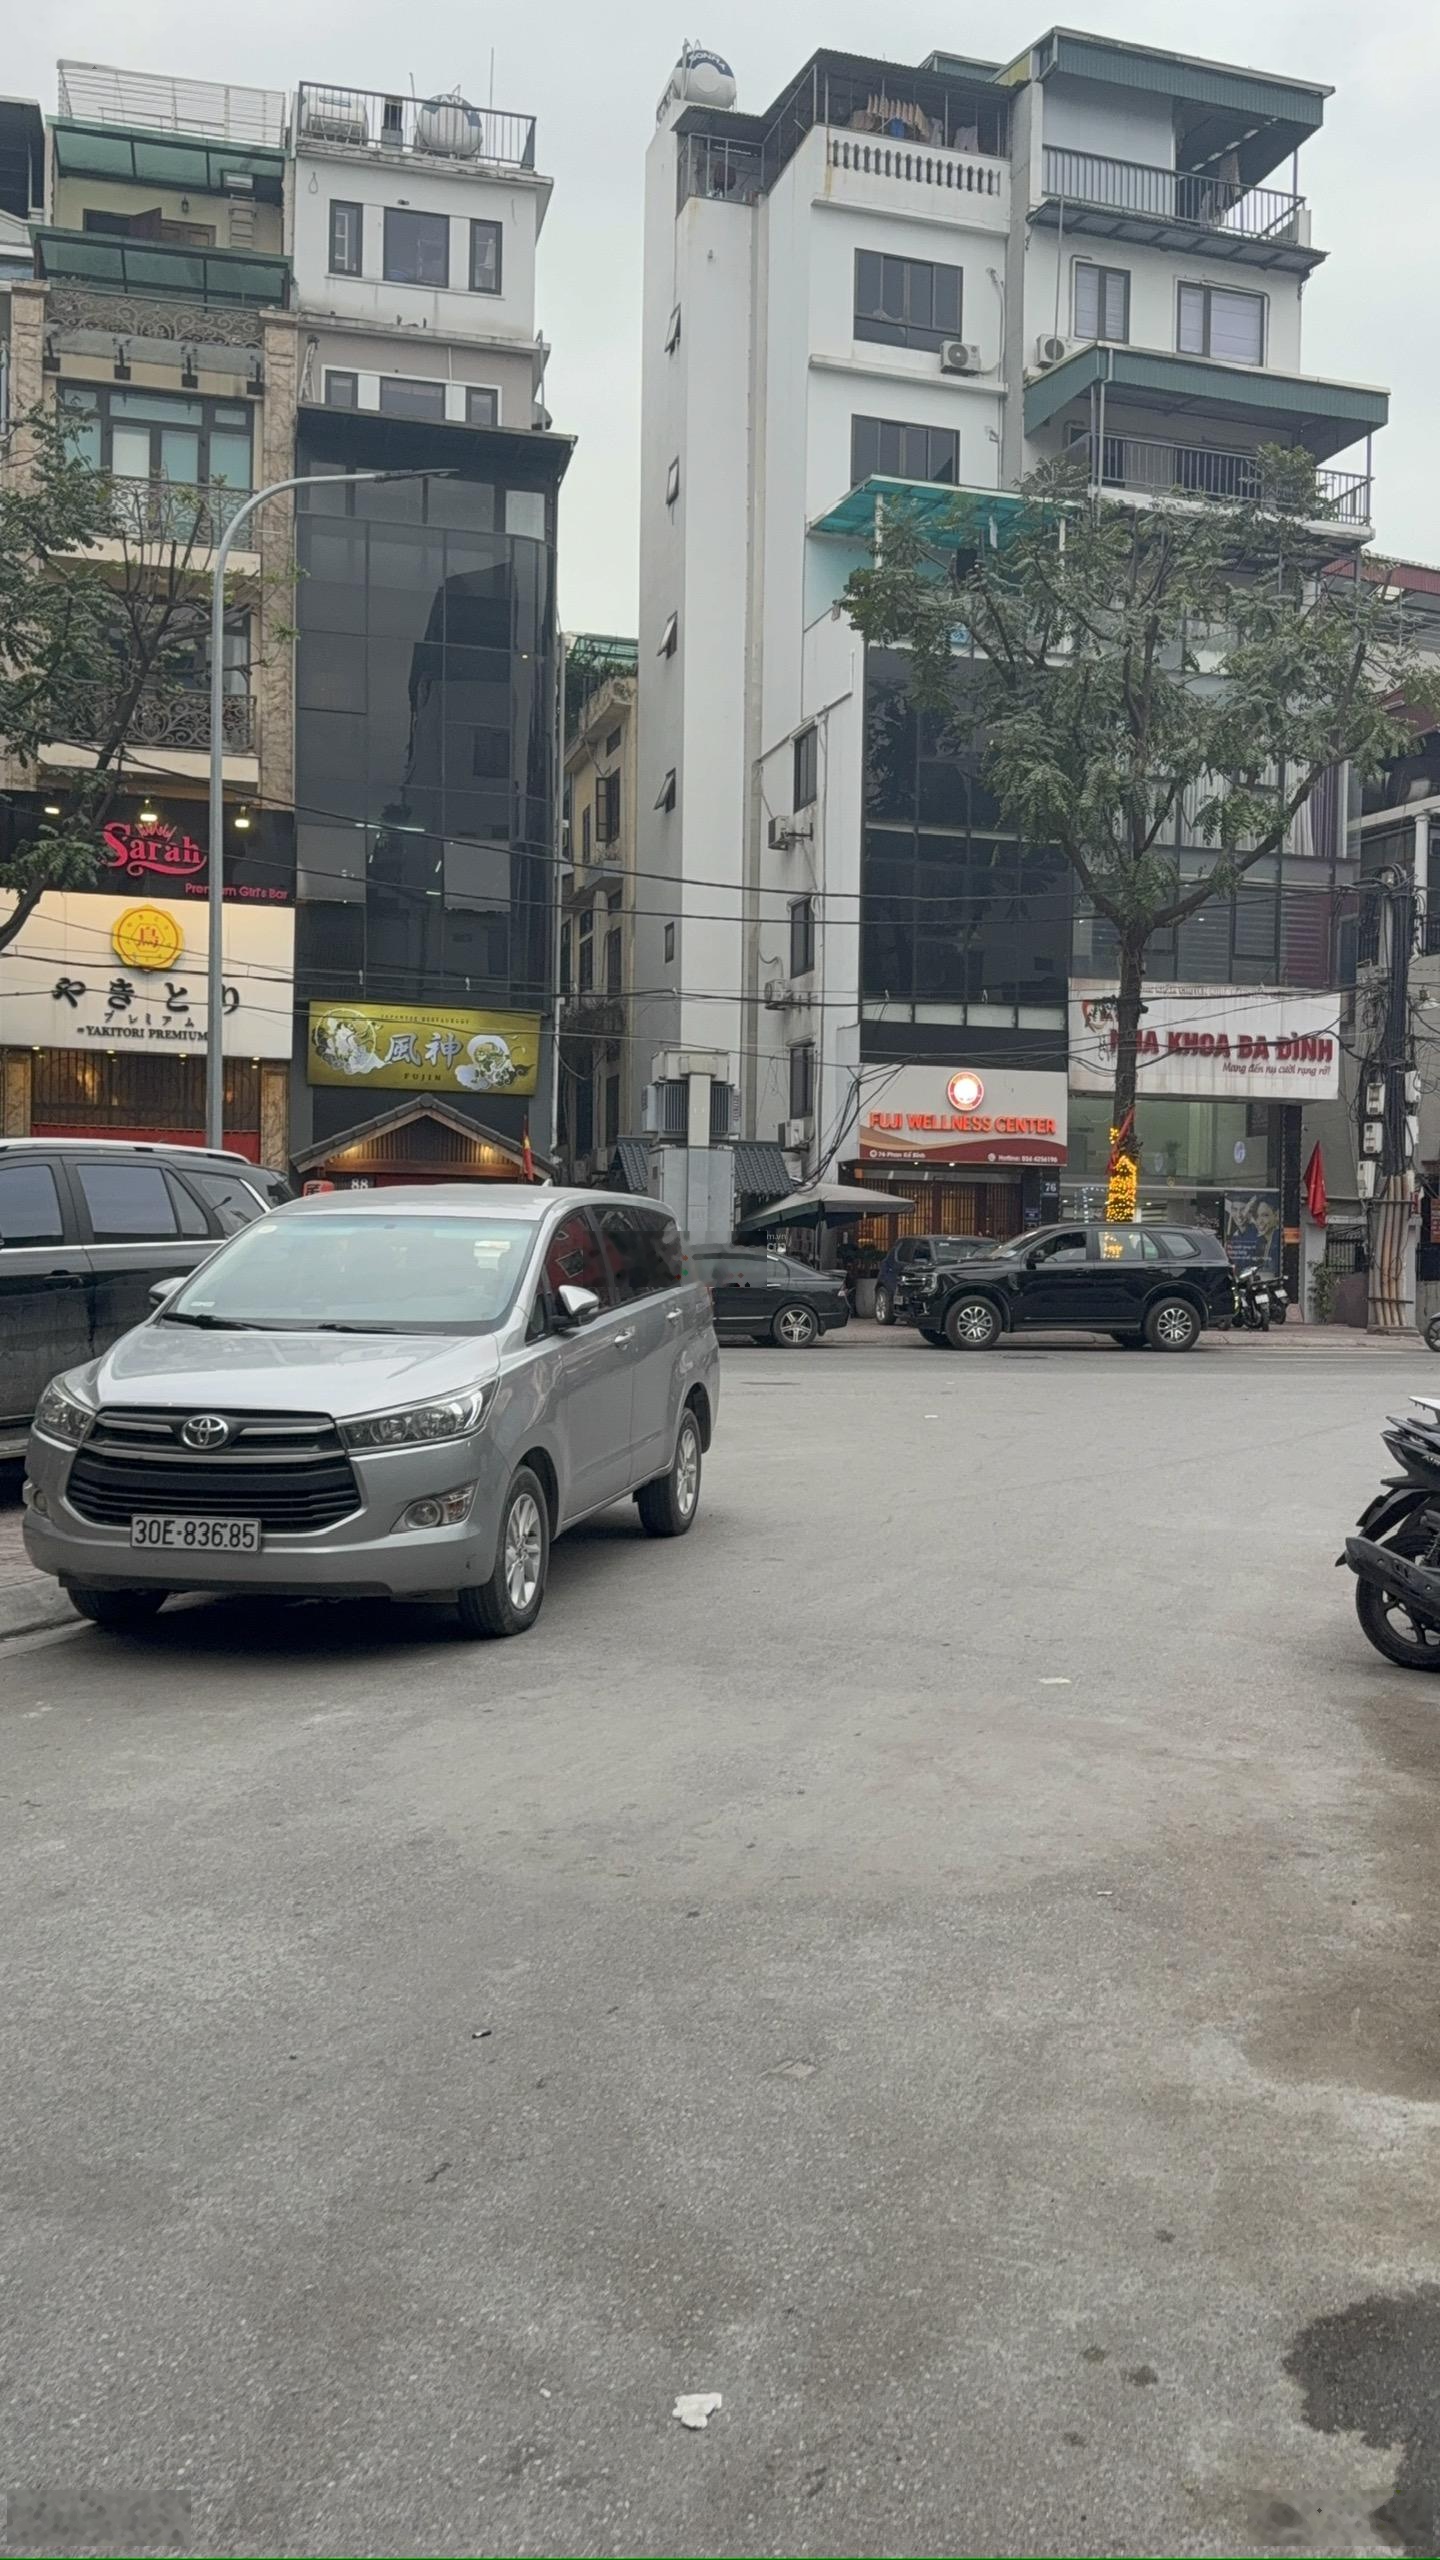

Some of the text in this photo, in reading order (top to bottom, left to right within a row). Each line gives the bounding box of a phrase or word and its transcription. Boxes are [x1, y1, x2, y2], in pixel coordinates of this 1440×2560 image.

[102, 822, 206, 875] Sarah
[268, 888, 288, 899] Bar
[52, 977, 240, 1015] やきとり
[86, 1025, 209, 1042] YAKITORI PREMIUM
[1167, 1032, 1231, 1058] KHOA
[1237, 1034, 1270, 1061] BA
[1275, 1031, 1334, 1063] ĐÌNH
[384, 1031, 464, 1071] 風神
[403, 1072, 442, 1081] FUJIN
[869, 1111, 1057, 1136] FUJI WELLNESS CENTER
[134, 1518, 256, 1548] 30E-836.85
